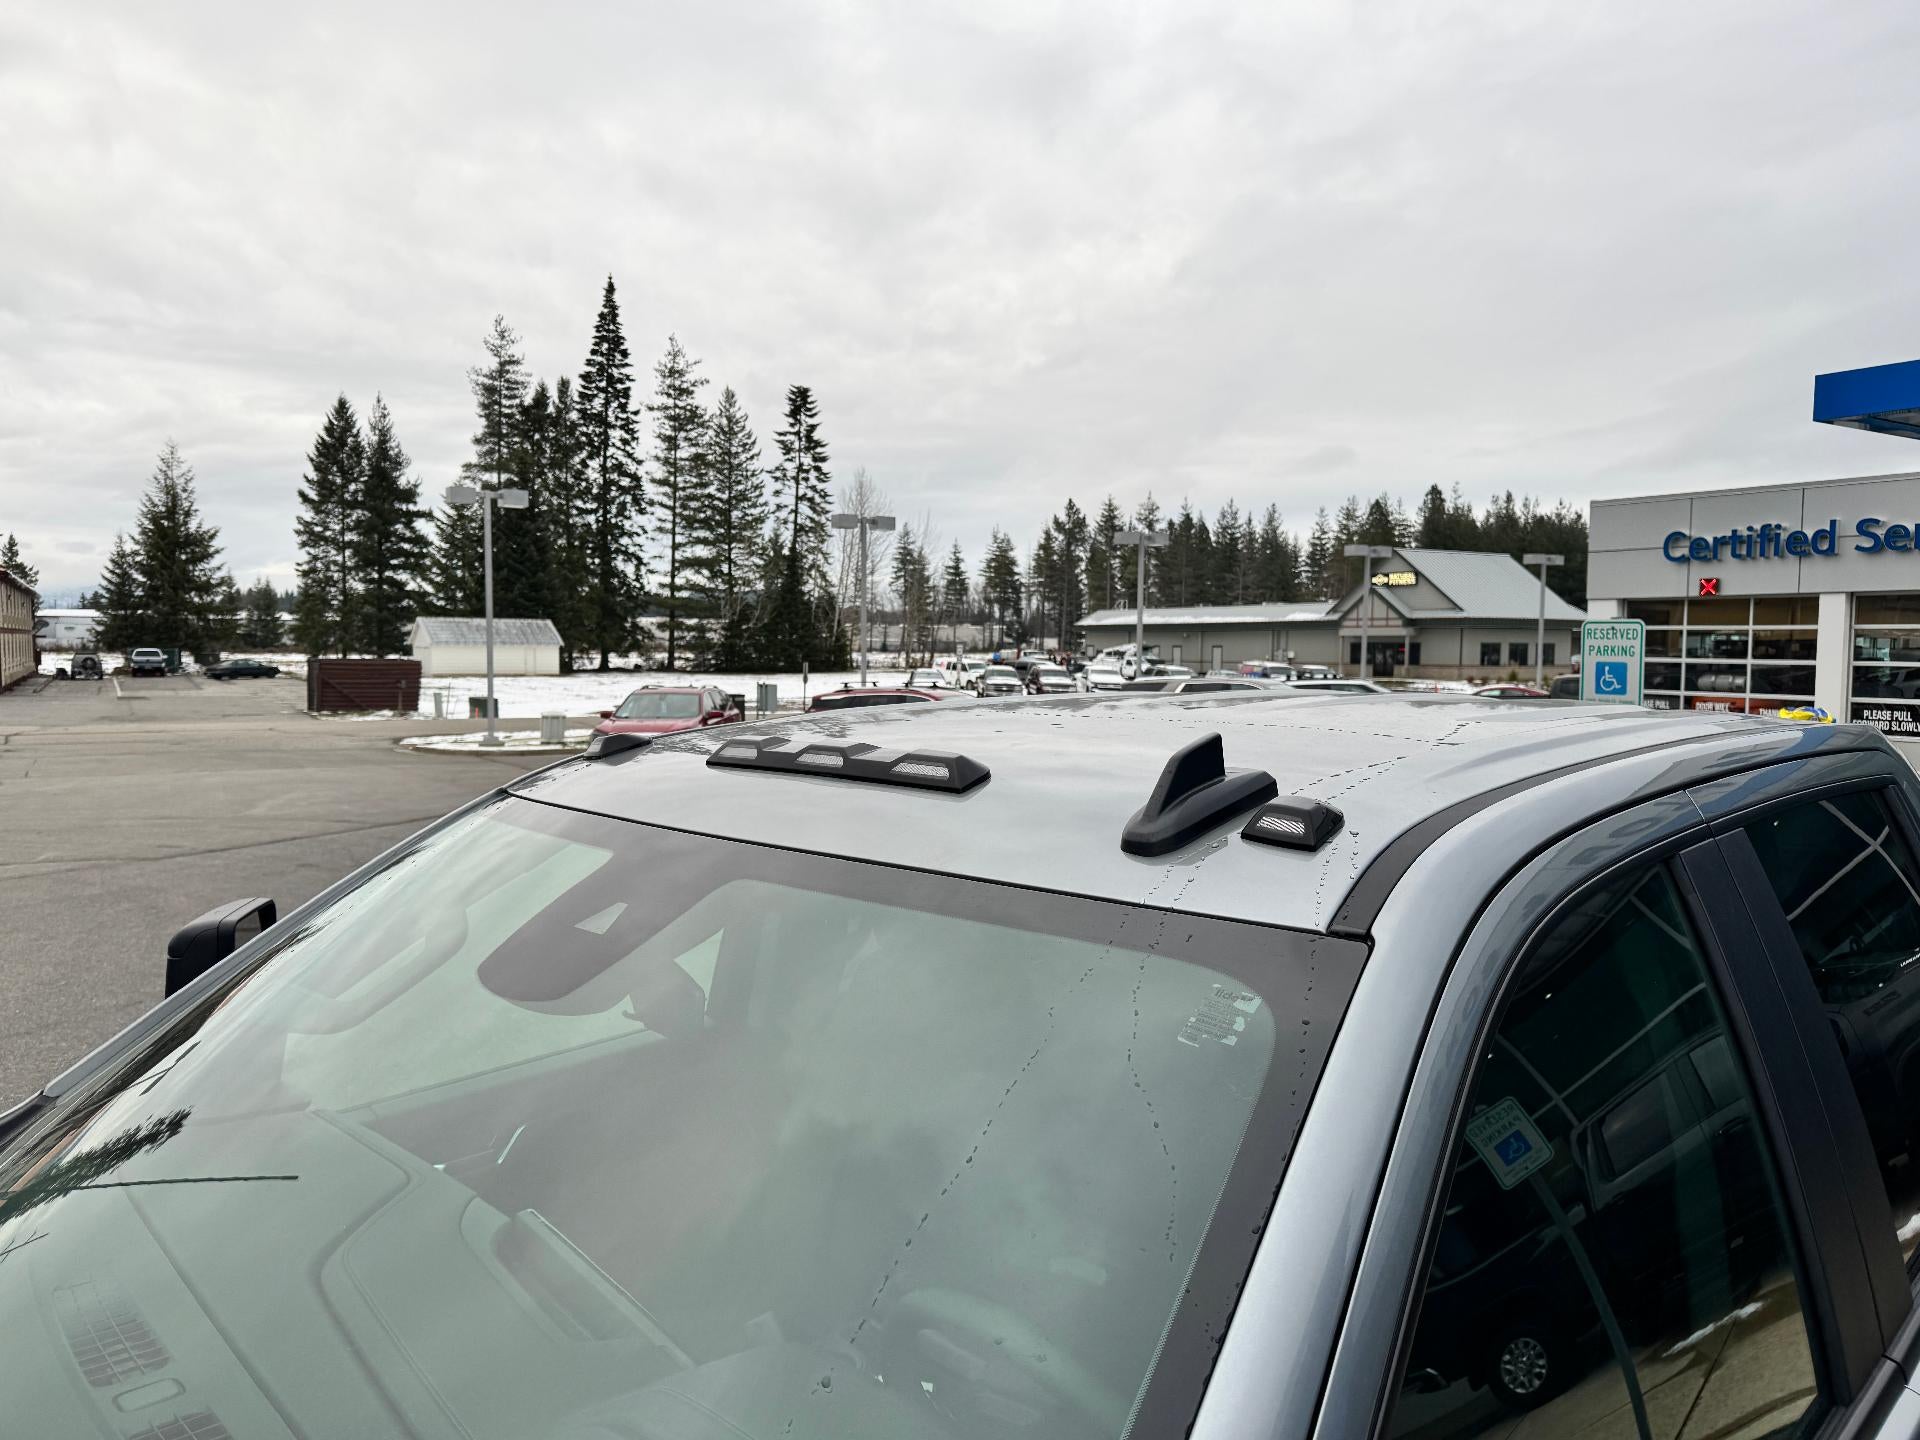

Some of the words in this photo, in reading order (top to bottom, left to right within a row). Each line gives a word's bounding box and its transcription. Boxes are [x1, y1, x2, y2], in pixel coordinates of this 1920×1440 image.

[1663, 519, 1839, 562] Certified
[1587, 628, 1639, 641] RESERVED
[1588, 645, 1635, 657] PARKING
[1863, 709, 1892, 721] PLEASE
[1893, 711, 1913, 722] PULL
